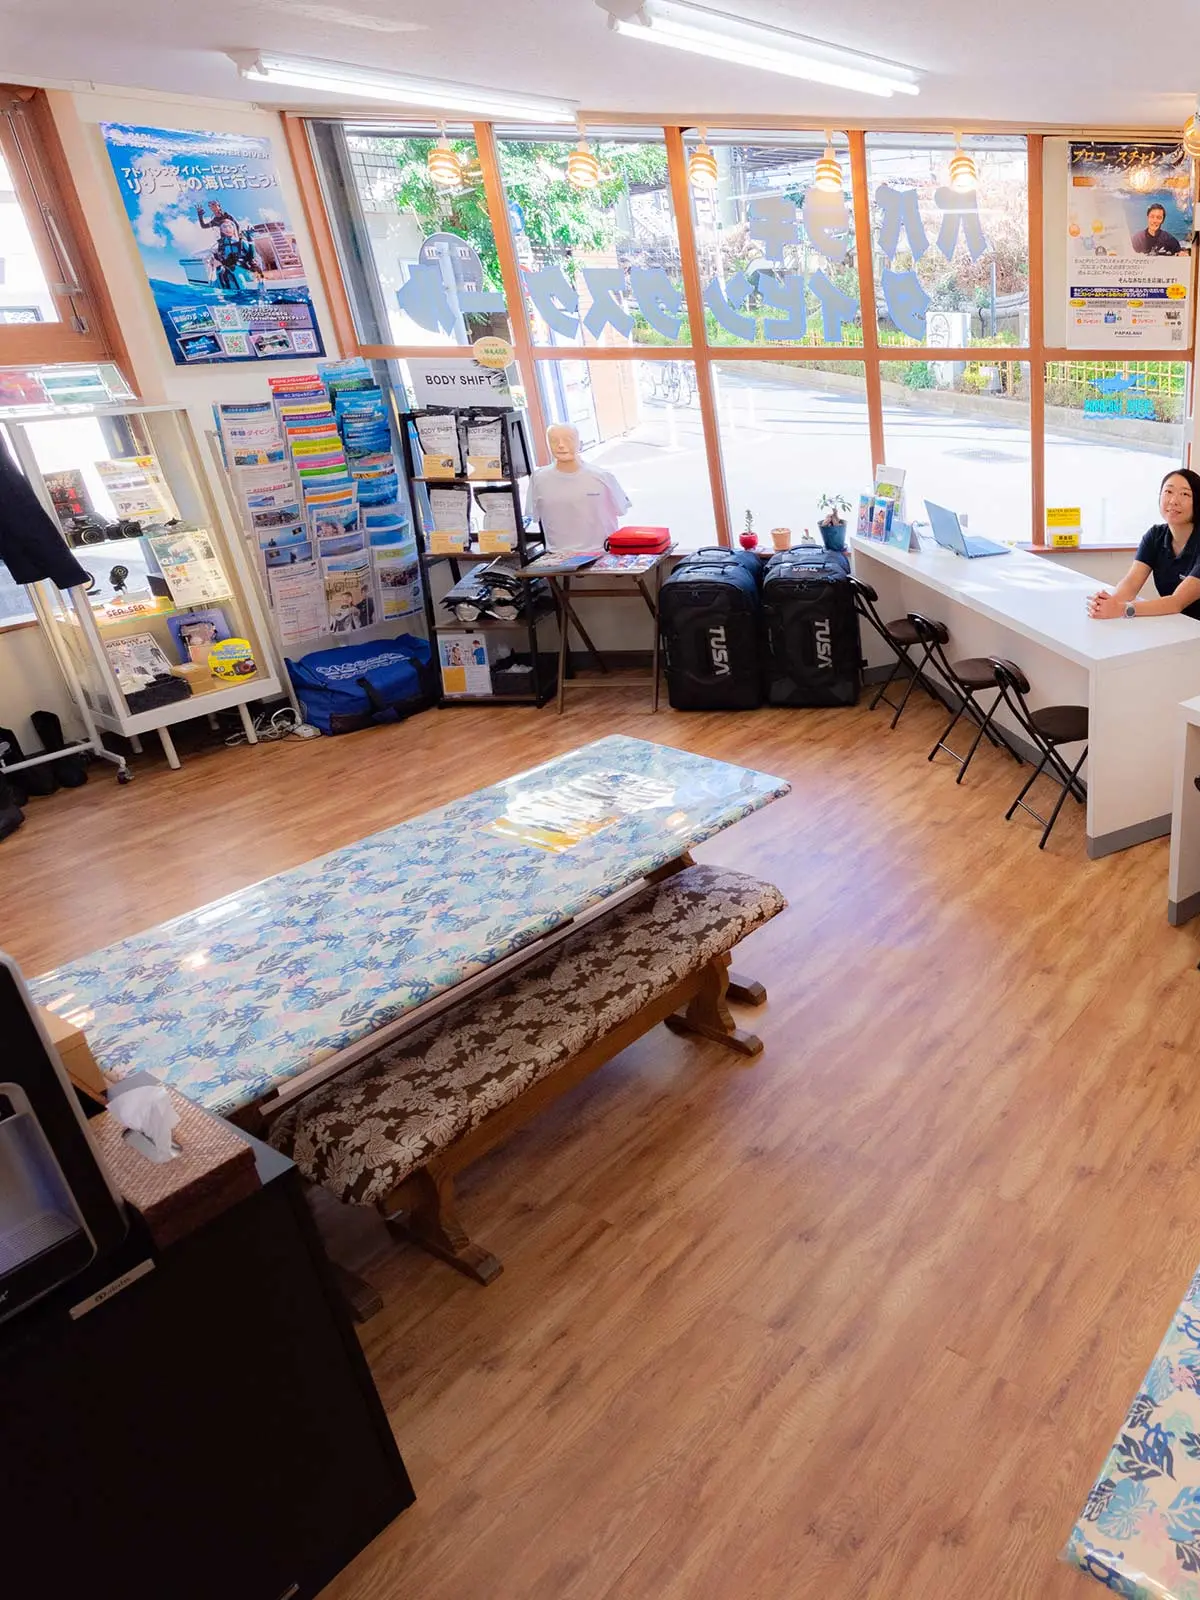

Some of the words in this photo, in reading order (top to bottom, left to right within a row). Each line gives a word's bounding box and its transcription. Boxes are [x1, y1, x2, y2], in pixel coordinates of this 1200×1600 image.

[425, 375, 457, 385] BODY
[460, 375, 492, 386] SHIFT
[709, 625, 731, 676] TUSA
[814, 619, 833, 668] TUSA
